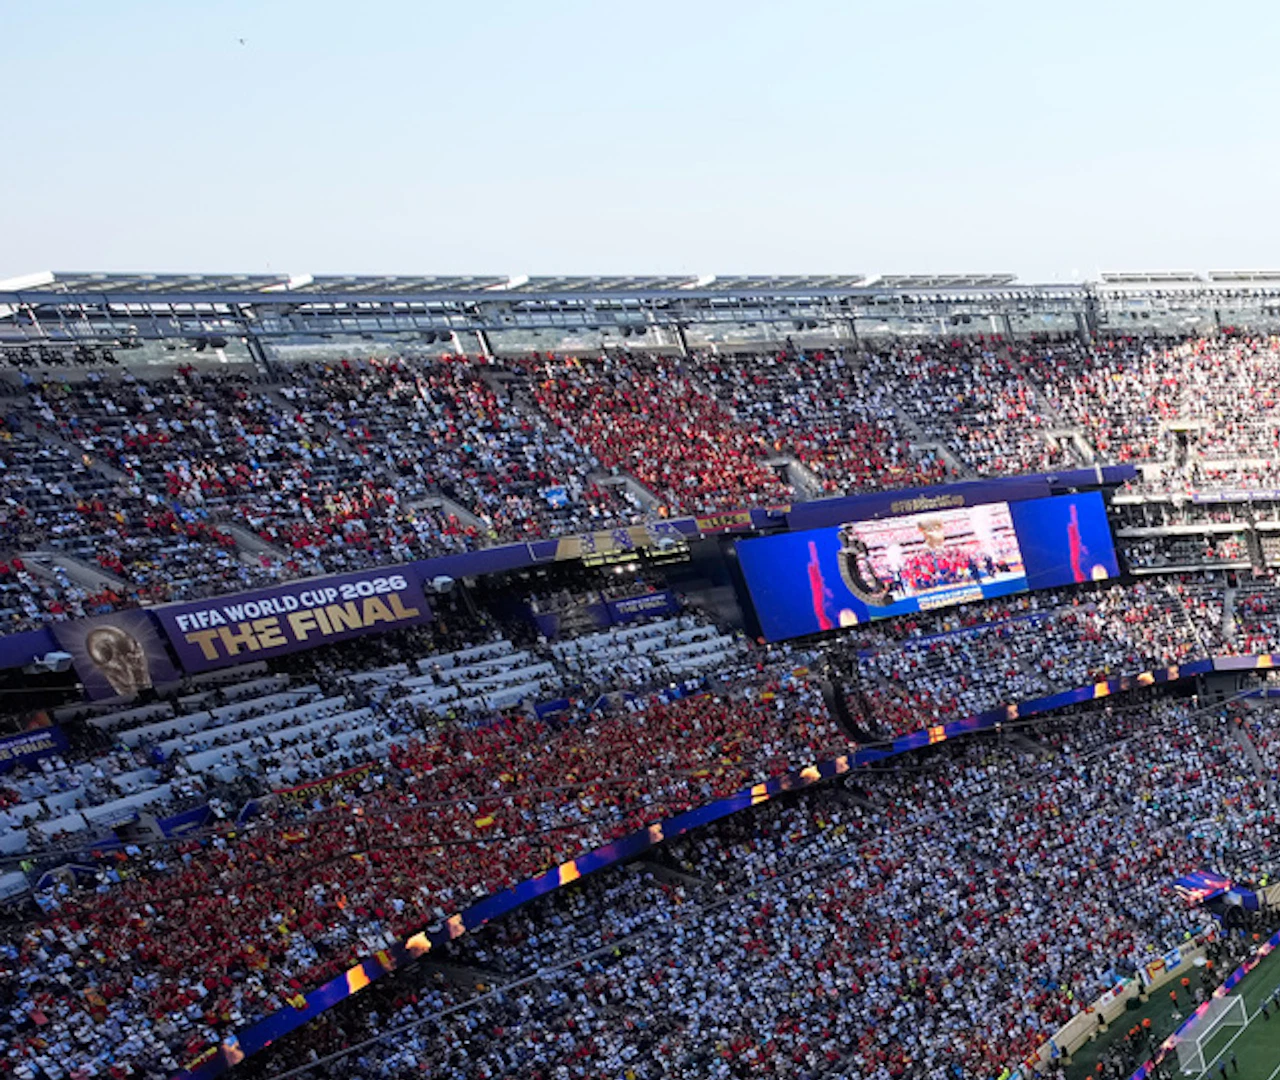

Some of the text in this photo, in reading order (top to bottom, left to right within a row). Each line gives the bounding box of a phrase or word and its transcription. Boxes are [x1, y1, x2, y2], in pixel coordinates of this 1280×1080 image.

[175, 575, 408, 632] FIFA WORLD CUP 2026
[184, 593, 420, 661] THE FINAL
